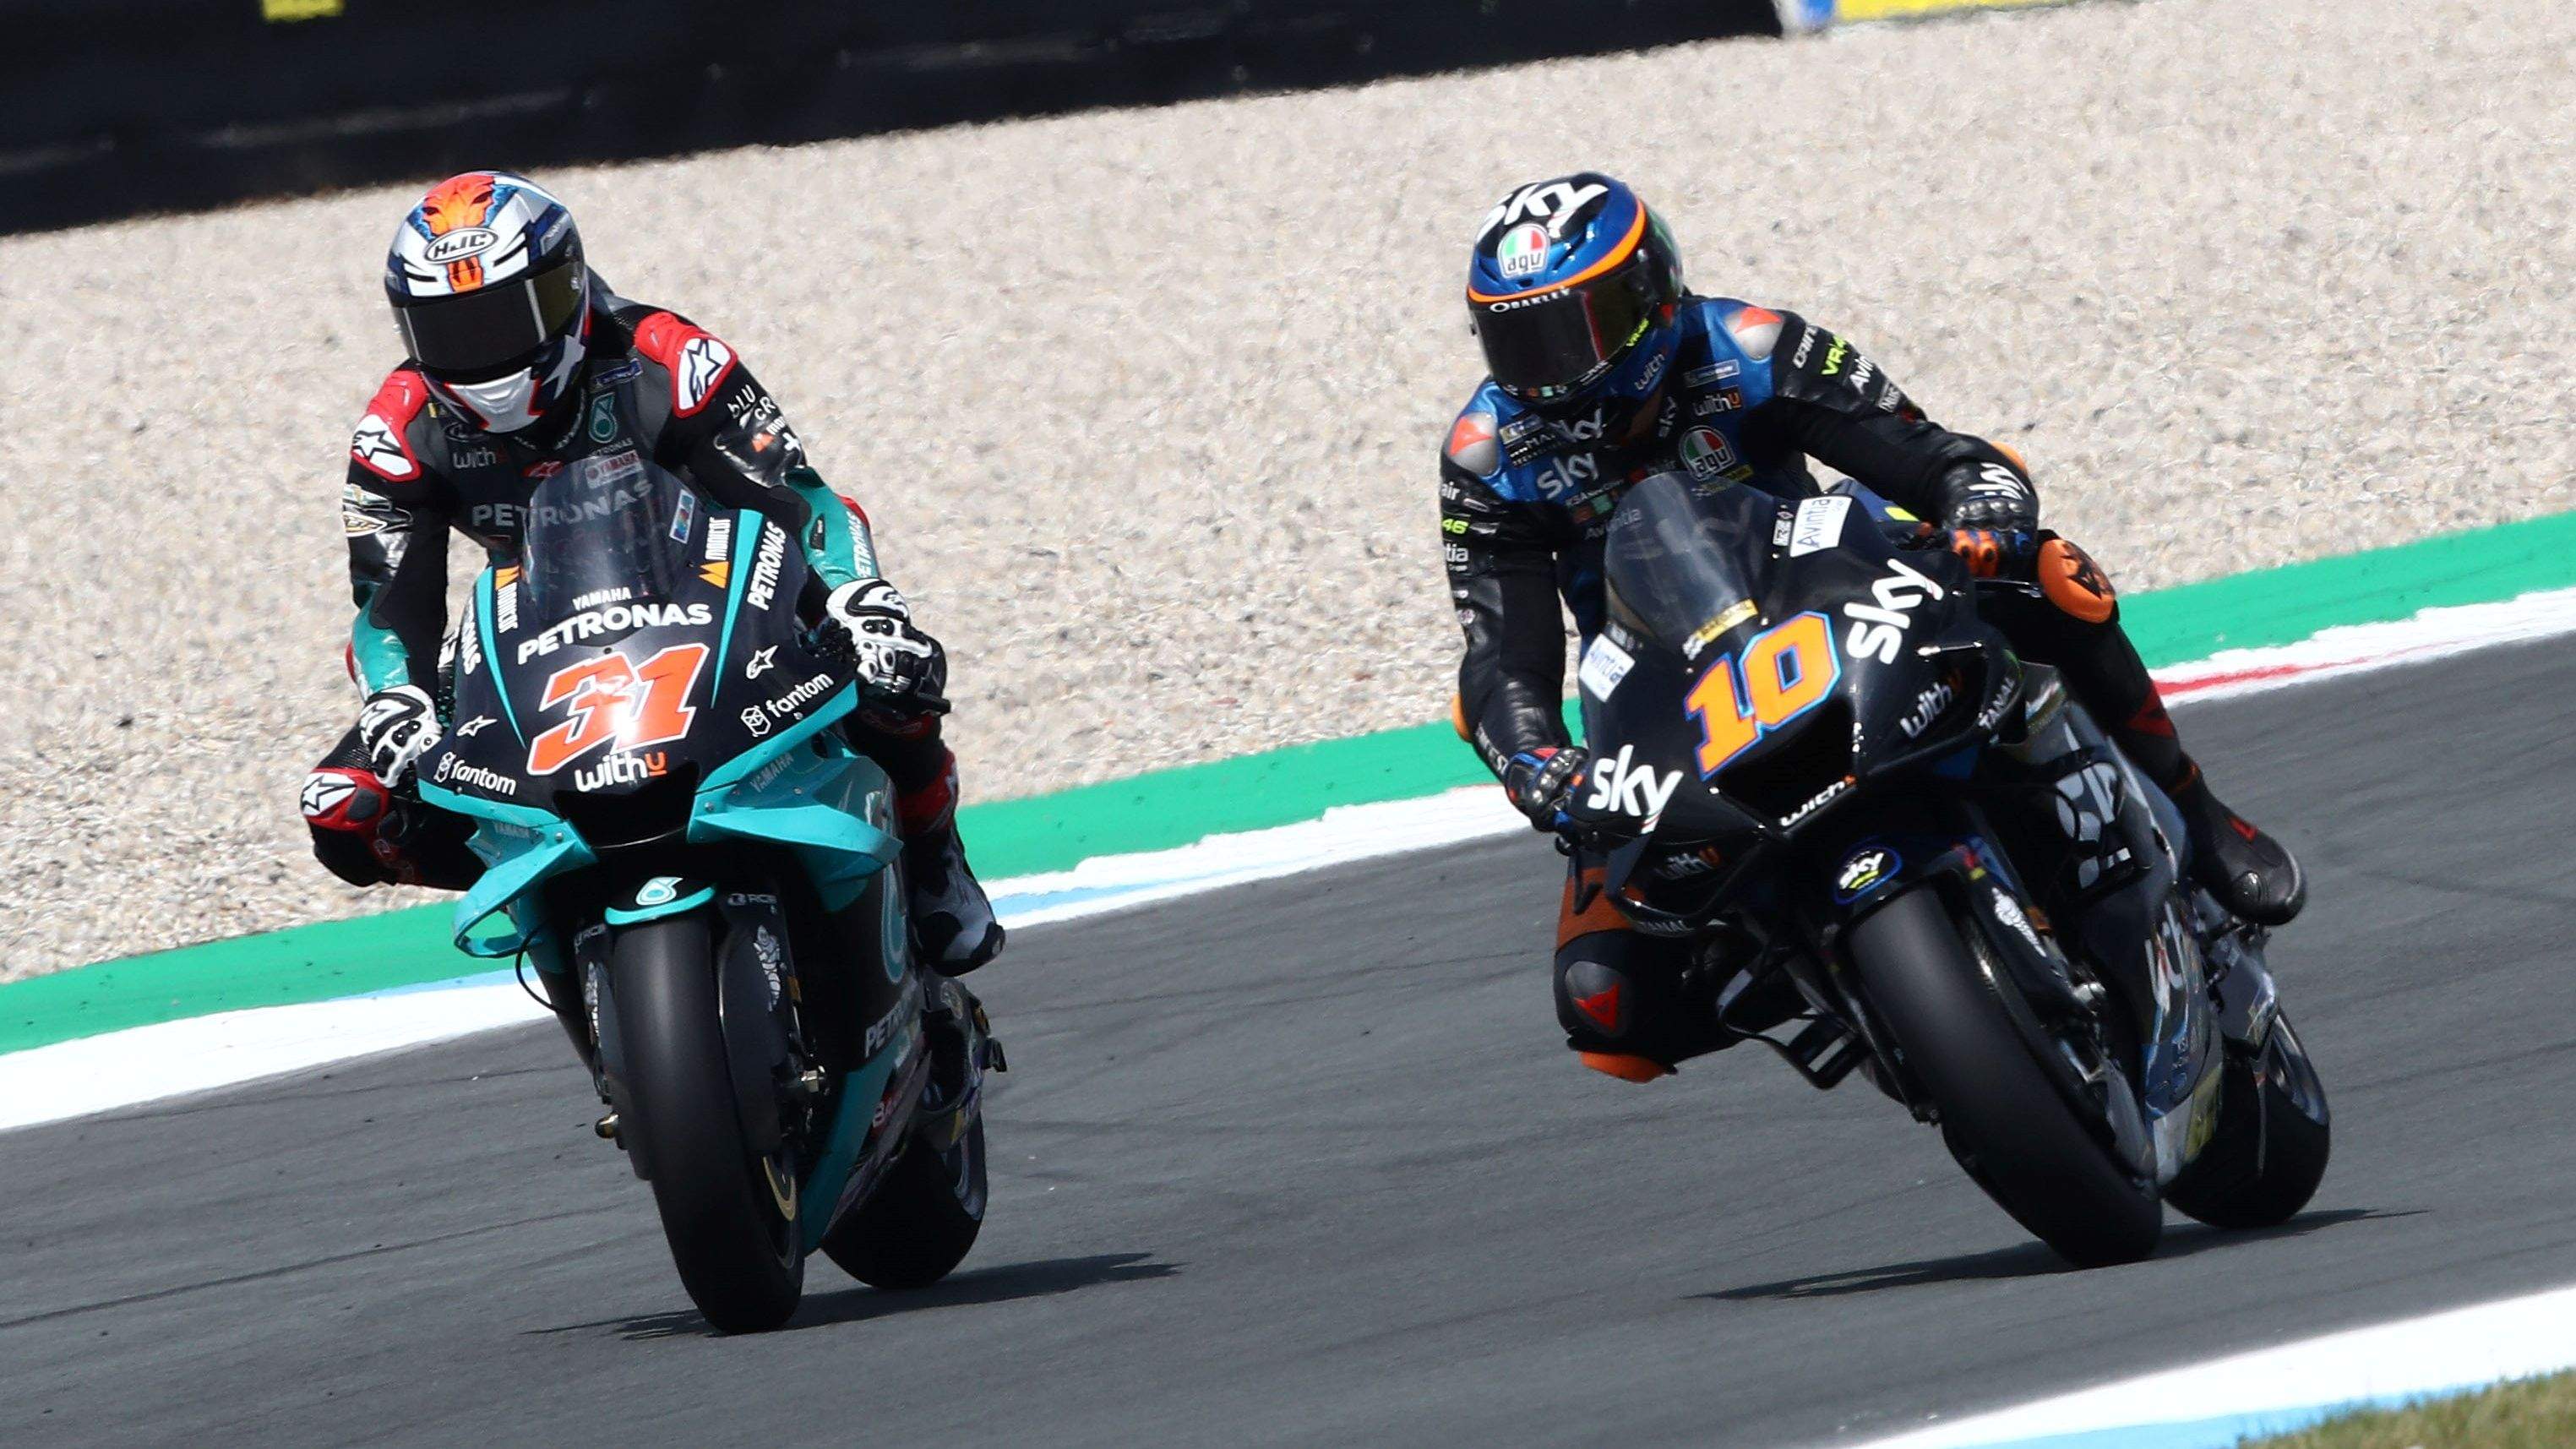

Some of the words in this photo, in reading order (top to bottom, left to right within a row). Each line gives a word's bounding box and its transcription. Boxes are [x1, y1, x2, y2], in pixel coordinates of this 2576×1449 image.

[433, 232, 487, 259] HJC
[1506, 251, 1543, 272] agv
[1490, 286, 1571, 313] OAKLEY
[471, 478, 654, 528] PETRONAS
[747, 520, 787, 611] PETRONAS
[572, 586, 632, 611] YAMAHA
[1843, 558, 1944, 665] sky
[518, 603, 713, 665] PETRONAS
[526, 642, 711, 776] 31
[766, 673, 835, 718] fantom
[1683, 609, 1844, 783] 10
[450, 759, 517, 797] fantom
[1587, 744, 1685, 835] sky
